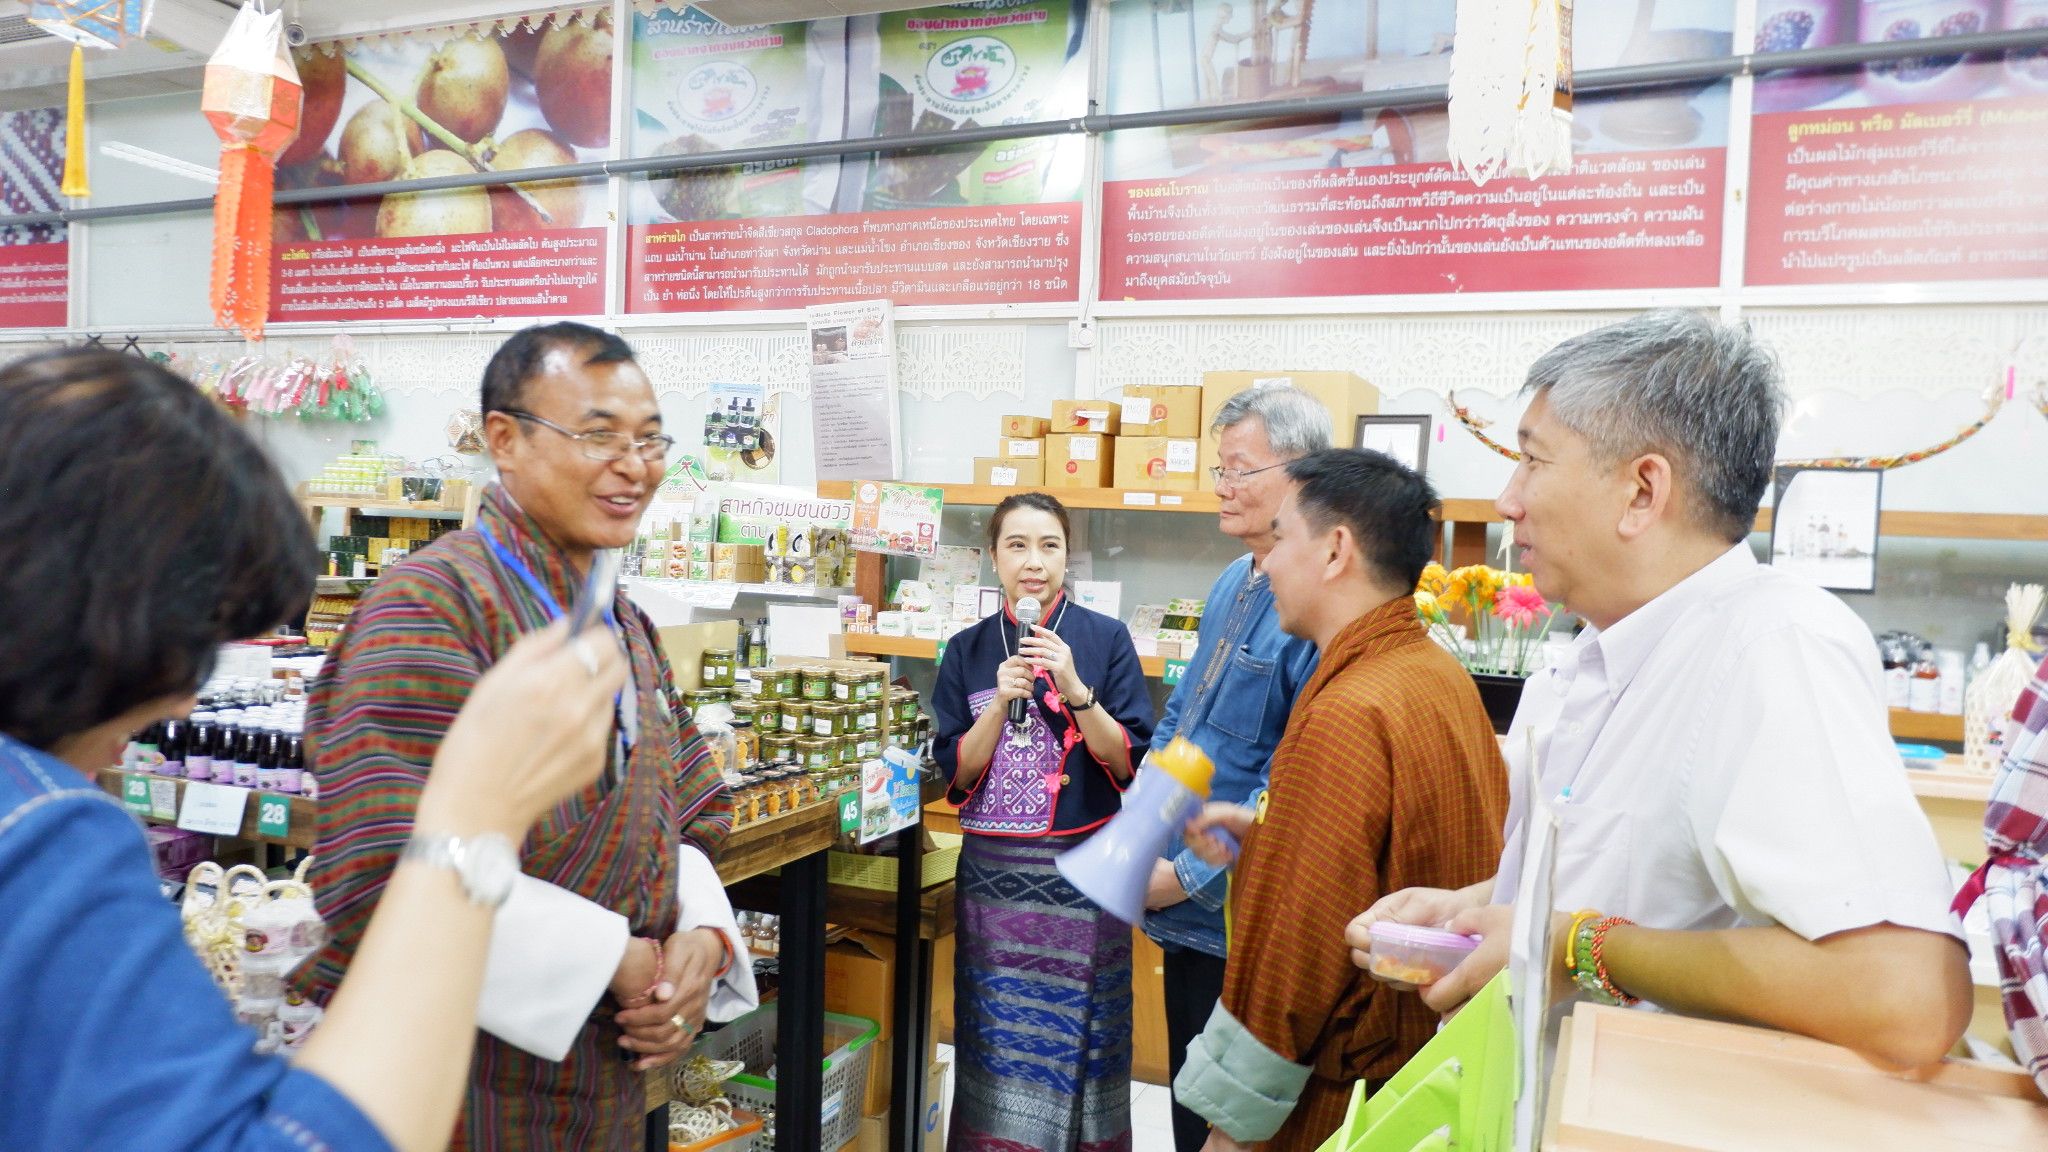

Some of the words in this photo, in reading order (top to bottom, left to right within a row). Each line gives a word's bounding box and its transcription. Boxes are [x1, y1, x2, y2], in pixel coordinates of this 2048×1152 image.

[1860, 112, 1894, 131] หรือ
[1128, 181, 1209, 199] ของเล่นโบราณ
[1652, 155, 1705, 172] ของเล่น
[1649, 178, 1705, 196] และเป็น
[1556, 207, 1638, 226] ความทรงจำ
[1644, 204, 1704, 222] ความฝัน
[645, 229, 686, 244] สาหร่ายไก
[806, 224, 859, 236] Cladophora
[863, 212, 1016, 232] ที่พบทางภาคเหนือของประเทศไทย
[1019, 211, 1069, 227] โดยเฉพาะ
[665, 246, 706, 262] แม่น้ำน่าน
[709, 246, 779, 260] ในอำเภอท่าวังผา
[783, 244, 832, 257] จังหวัดน่าน
[835, 237, 896, 255] และแม่น้ำโขง
[900, 237, 971, 252] อำเภอเชียงของ
[975, 234, 1051, 249] จังหวัดเชียงราย
[1055, 230, 1069, 246] ซึ่ง
[643, 263, 809, 282] สาหร่ายชนิดนี้สามารถนำมารับประทานได้
[816, 261, 949, 280] มักถูกนำมารับประทานแบบสด
[952, 255, 1068, 273] และยังสามารถนำมาปรุง
[1125, 271, 1231, 289] มาถึงยุคสมัยปัจจุบัน
[662, 289, 674, 300] ยำ
[1028, 280, 1041, 290] 18
[1045, 276, 1068, 289] ชนิด
[721, 497, 851, 522] สาหกิจชุมชนชีววิ
[1167, 664, 1186, 679] 79
[843, 800, 858, 822] 45
